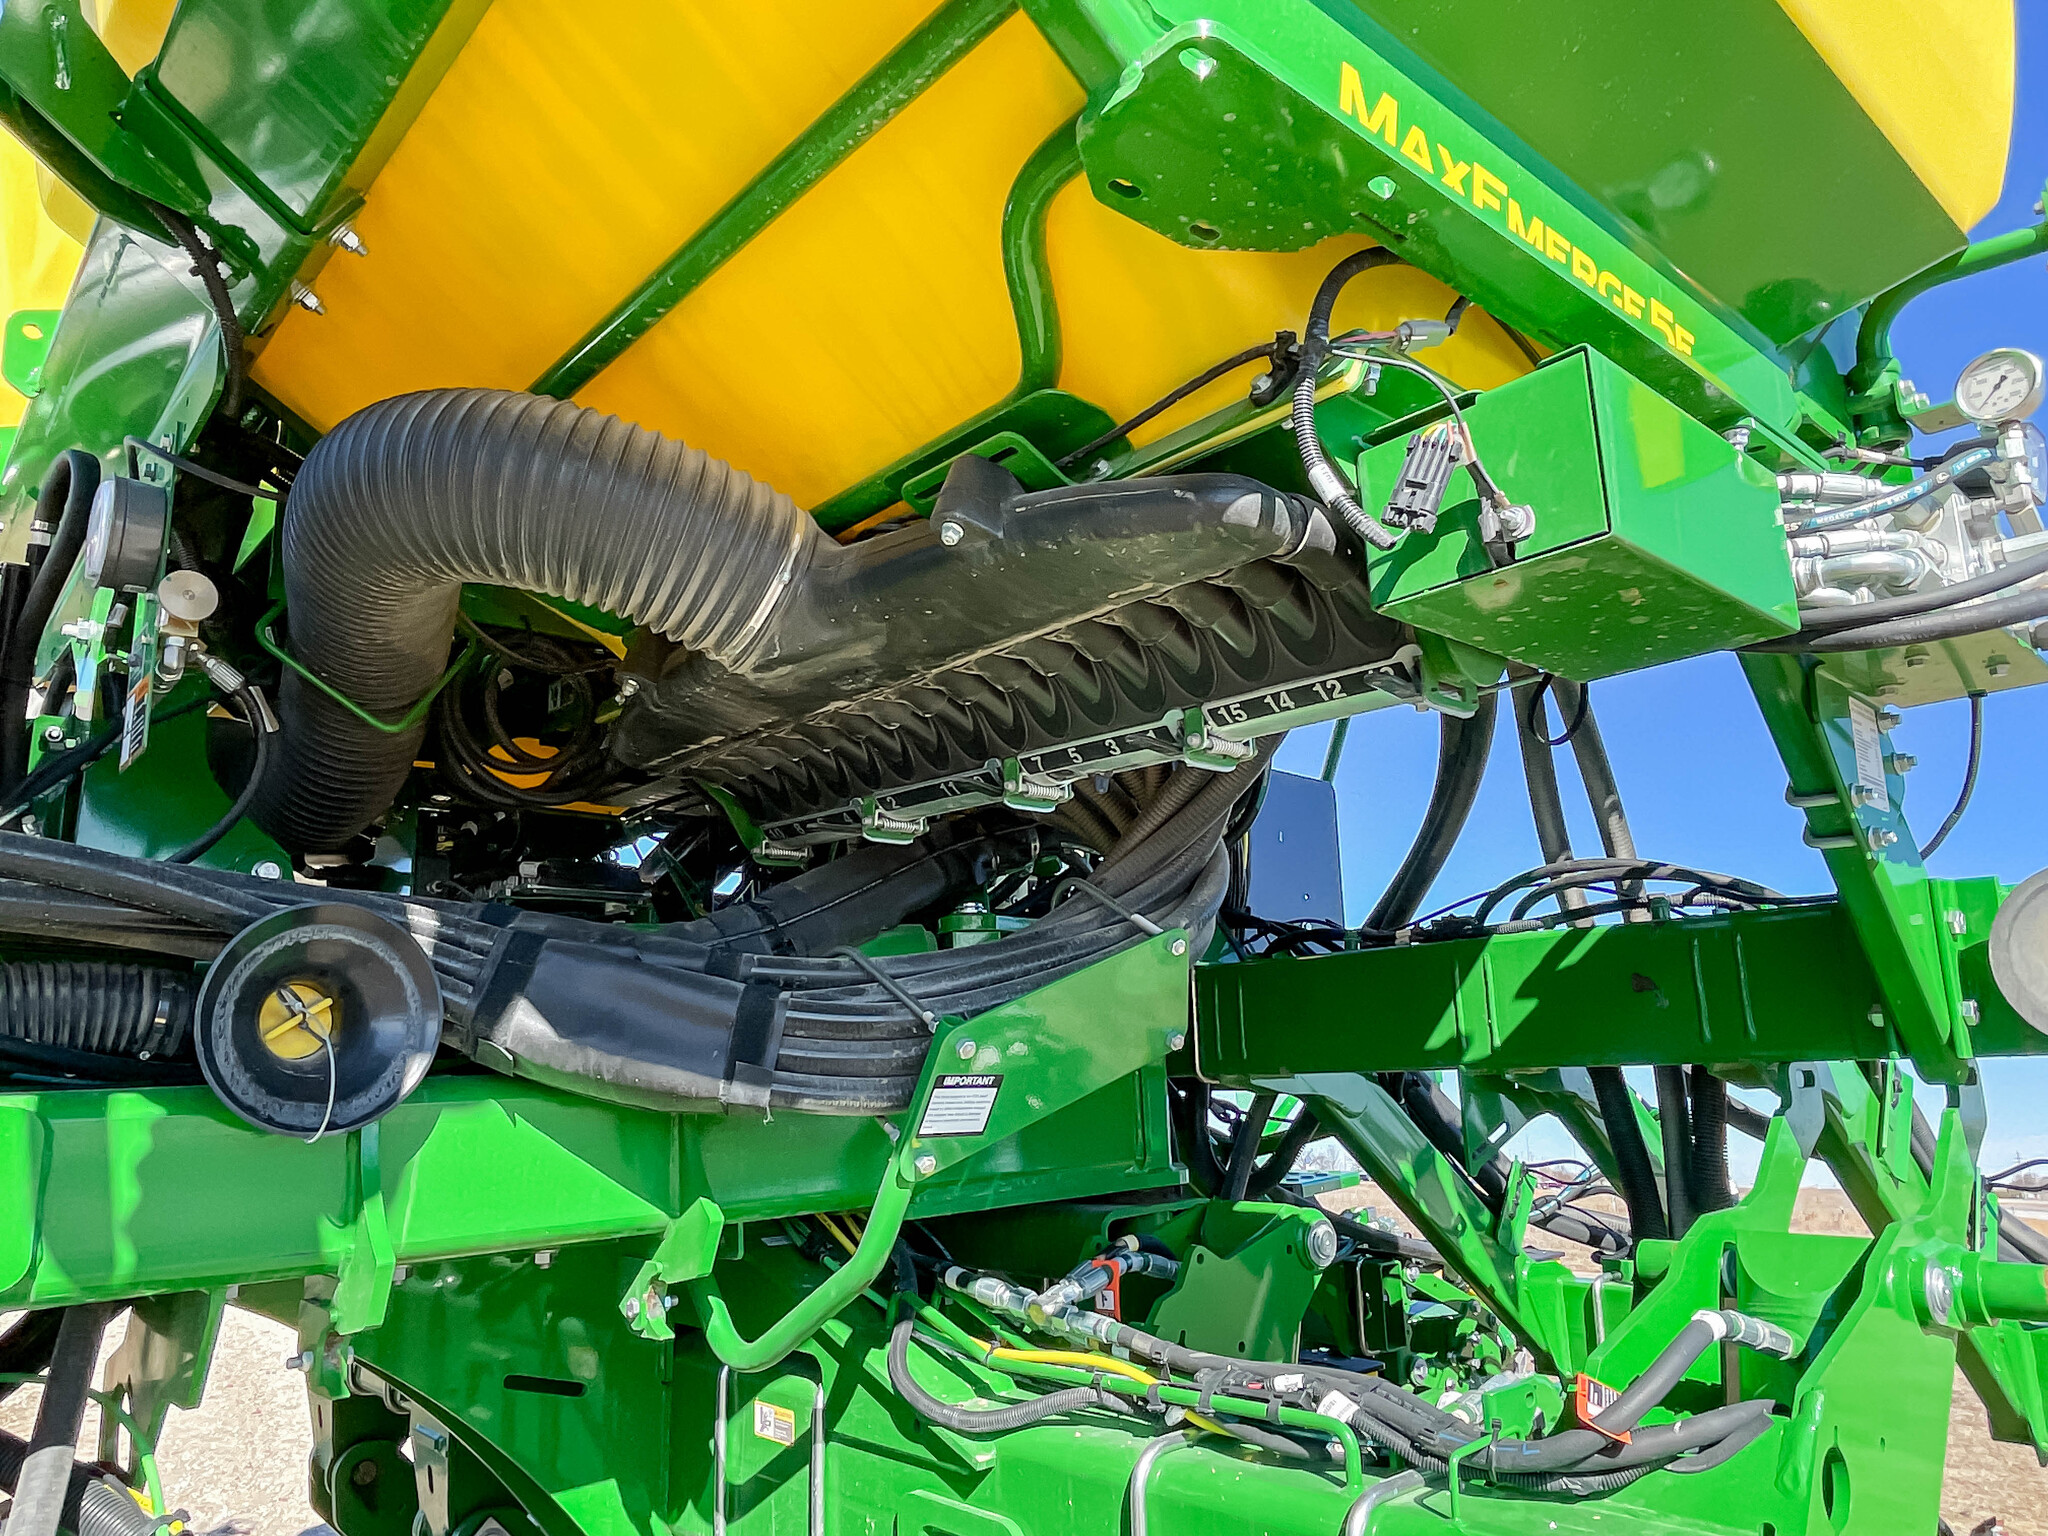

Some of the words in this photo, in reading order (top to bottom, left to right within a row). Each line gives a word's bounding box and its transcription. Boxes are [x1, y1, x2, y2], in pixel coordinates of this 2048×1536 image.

[1217, 703, 1248, 725] 15
[1263, 691, 1295, 714] 14
[1312, 679, 1347, 702] 12
[1030, 755, 1045, 772] 7
[1067, 747, 1083, 764] 5
[1104, 738, 1122, 756] 3
[886, 796, 901, 809] 2
[939, 781, 961, 797] 11
[942, 1076, 996, 1086] IMPORTANT
